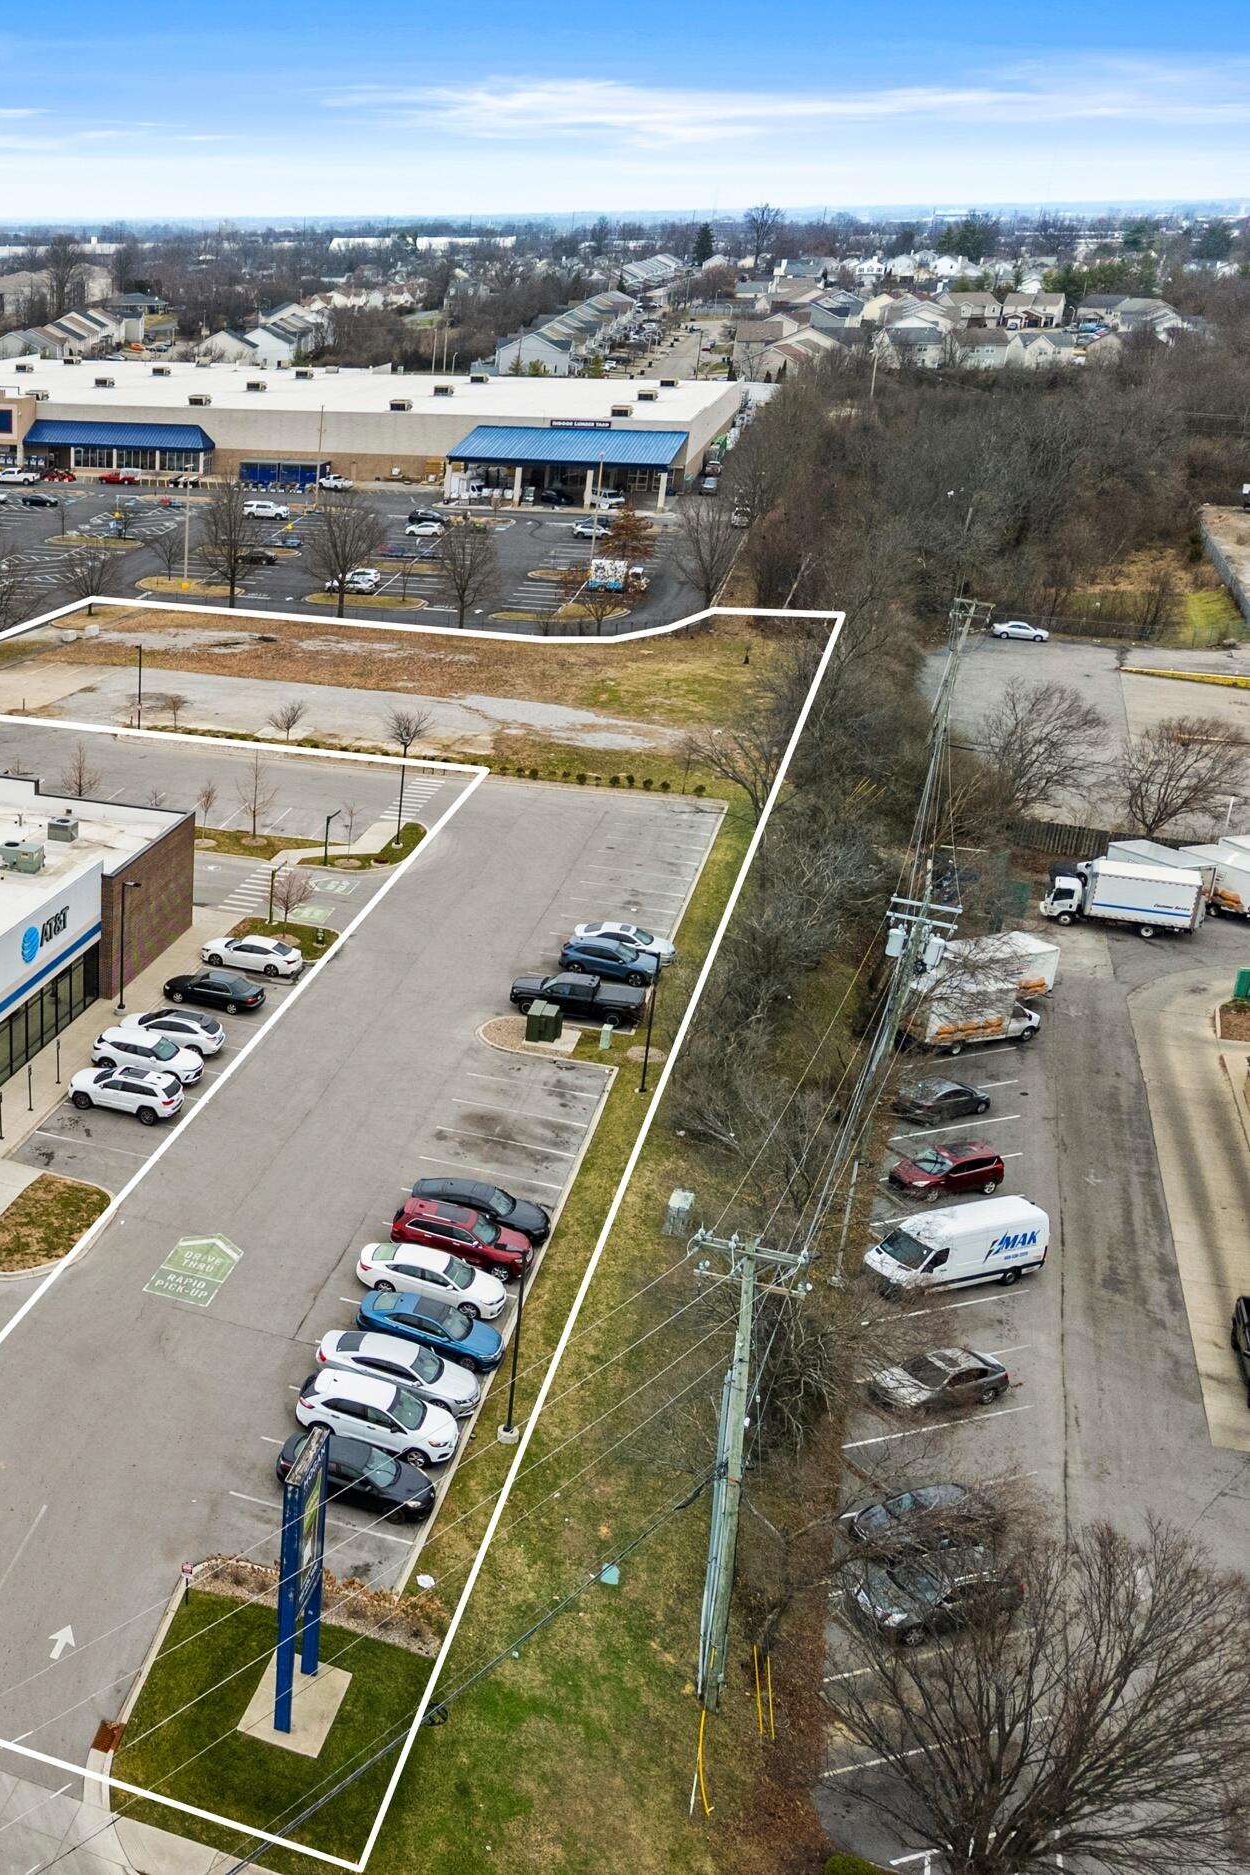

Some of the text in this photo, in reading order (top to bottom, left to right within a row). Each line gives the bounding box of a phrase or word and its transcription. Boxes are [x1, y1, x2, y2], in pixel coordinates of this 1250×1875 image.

[39, 905, 70, 947] AT&T
[182, 1259, 214, 1272] THRU
[184, 1250, 223, 1266] DRIVE
[155, 1280, 208, 1298] PICK-UP
[167, 1273, 206, 1289] RAPID
